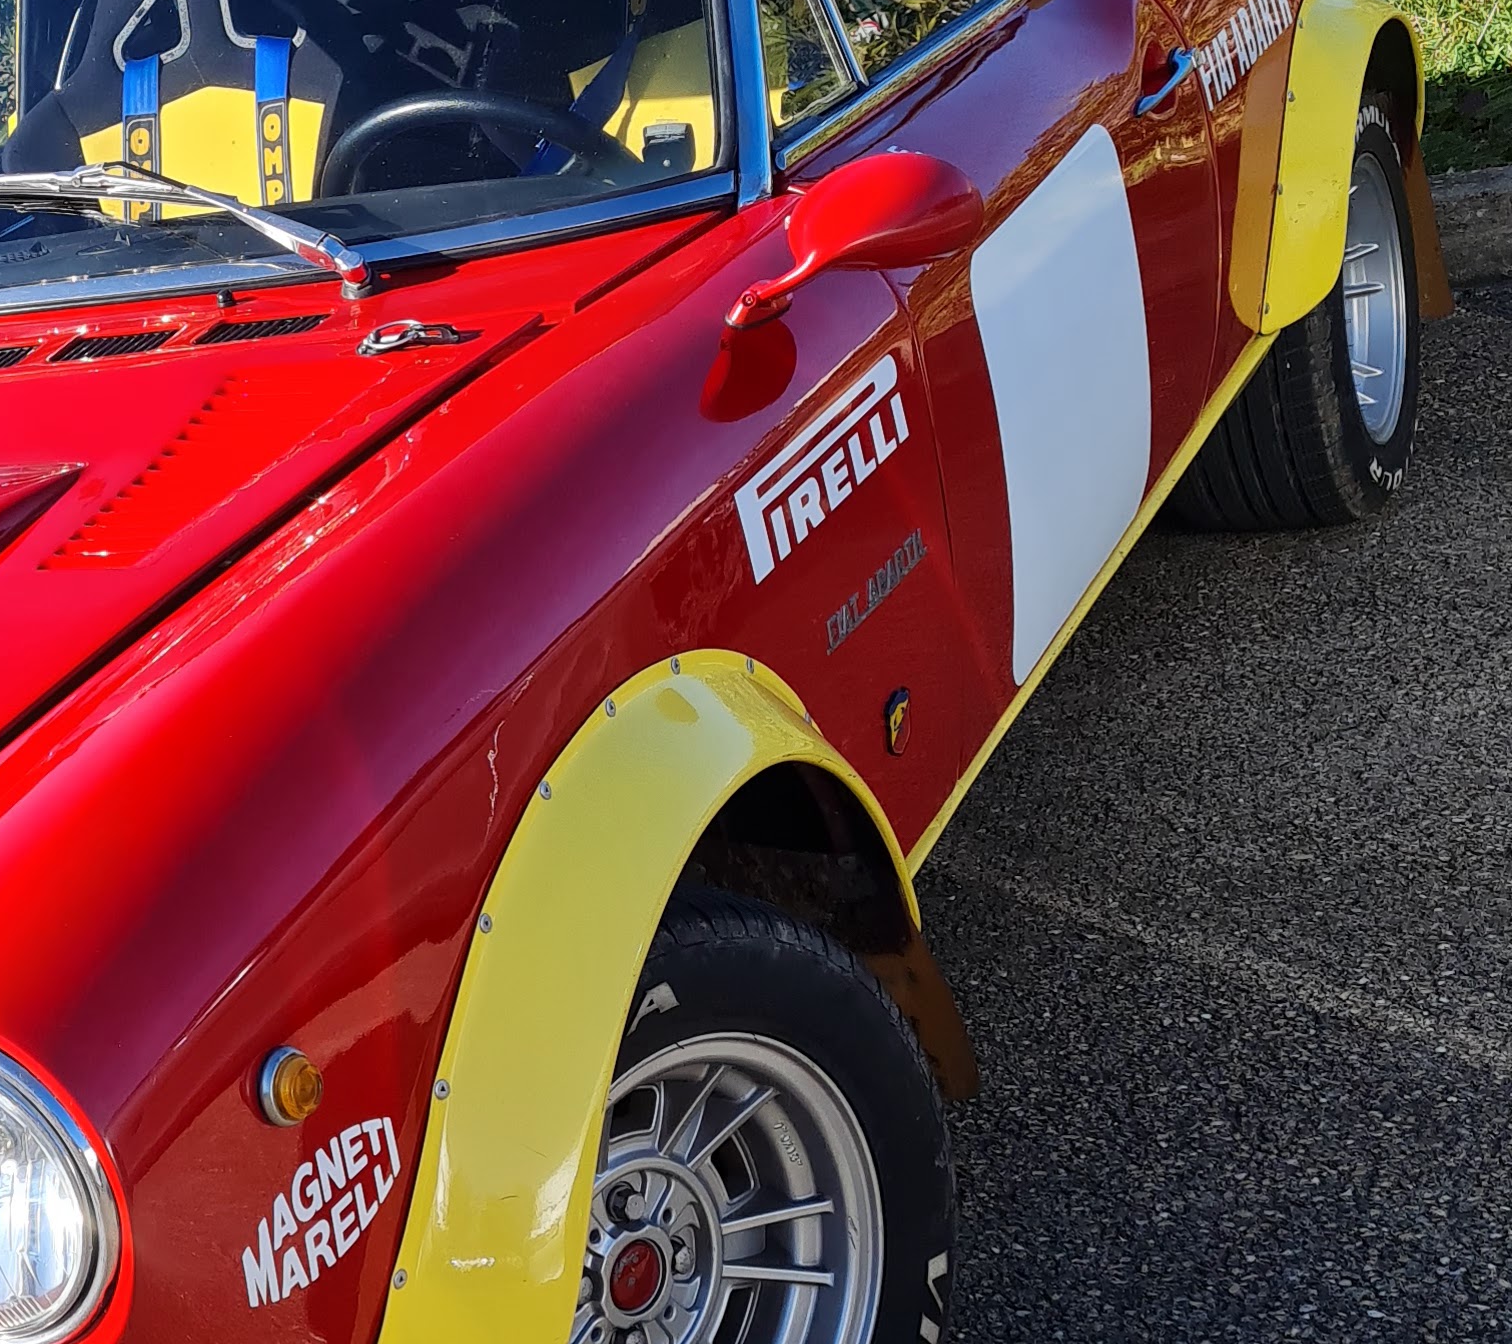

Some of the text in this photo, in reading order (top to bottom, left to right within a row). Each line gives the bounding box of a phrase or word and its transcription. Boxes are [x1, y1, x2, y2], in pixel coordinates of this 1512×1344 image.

[262, 113, 284, 206] OMP
[733, 353, 910, 586] PIRELLI
[826, 528, 928, 653] FIAT ABARTH
[241, 1116, 401, 1308] MAGNETI
[241, 1164, 401, 1308] MARELLI
